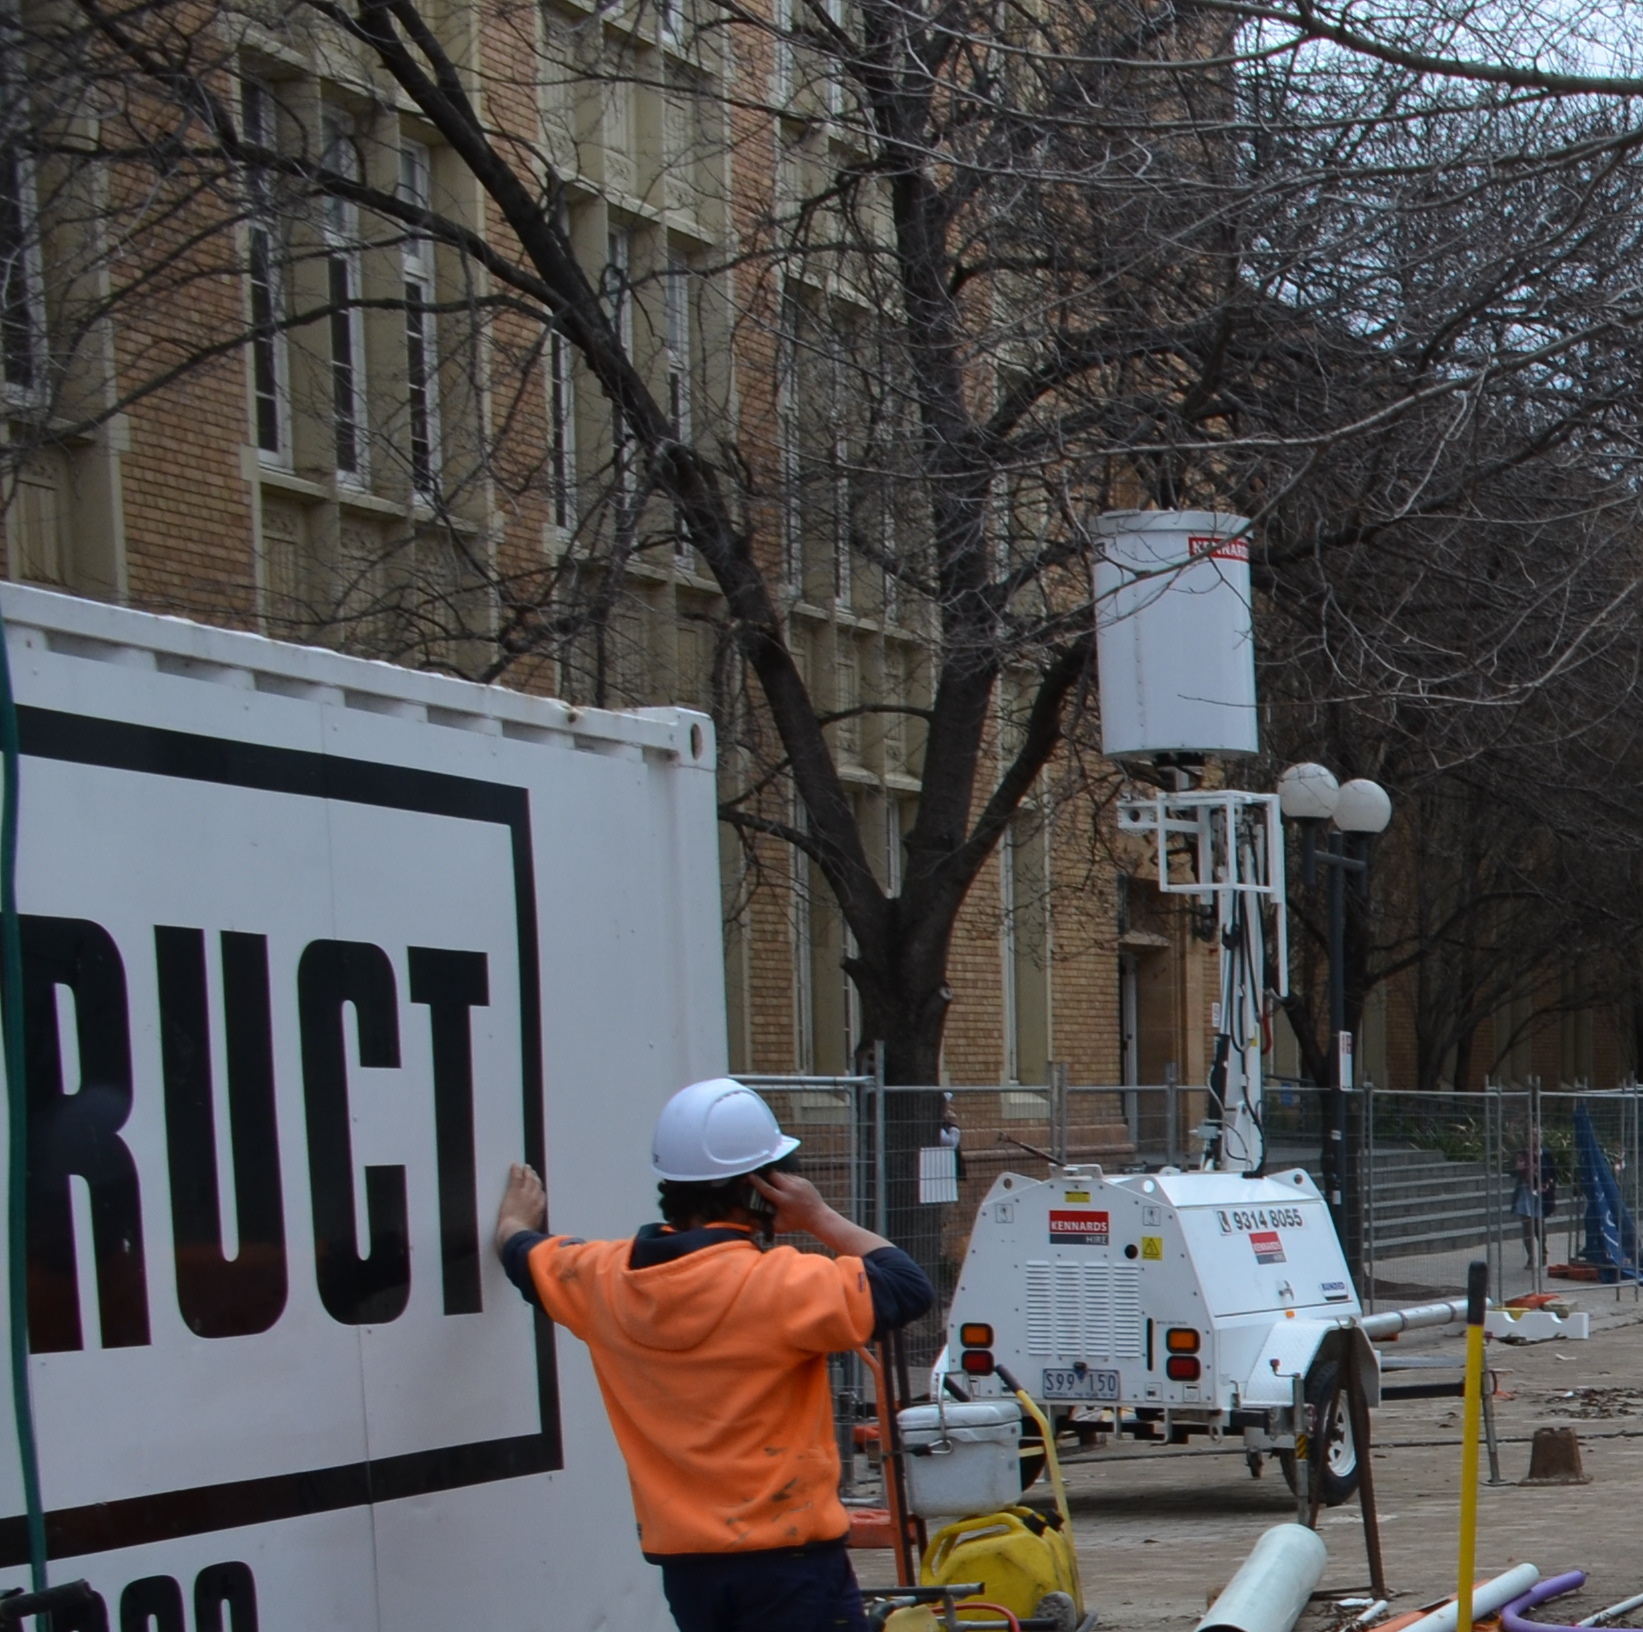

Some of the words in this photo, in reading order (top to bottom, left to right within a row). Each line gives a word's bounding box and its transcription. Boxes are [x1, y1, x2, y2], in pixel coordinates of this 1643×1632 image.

[2, 913, 490, 1354] RUCT
[1050, 1220, 1108, 1233] KENNARDS
[1233, 1210, 1268, 1231] 9314
[1271, 1208, 1303, 1228] 8055
[1086, 1234, 1108, 1245] HIRE
[1045, 1372, 1075, 1391] S99
[1089, 1373, 1117, 1392] 150
